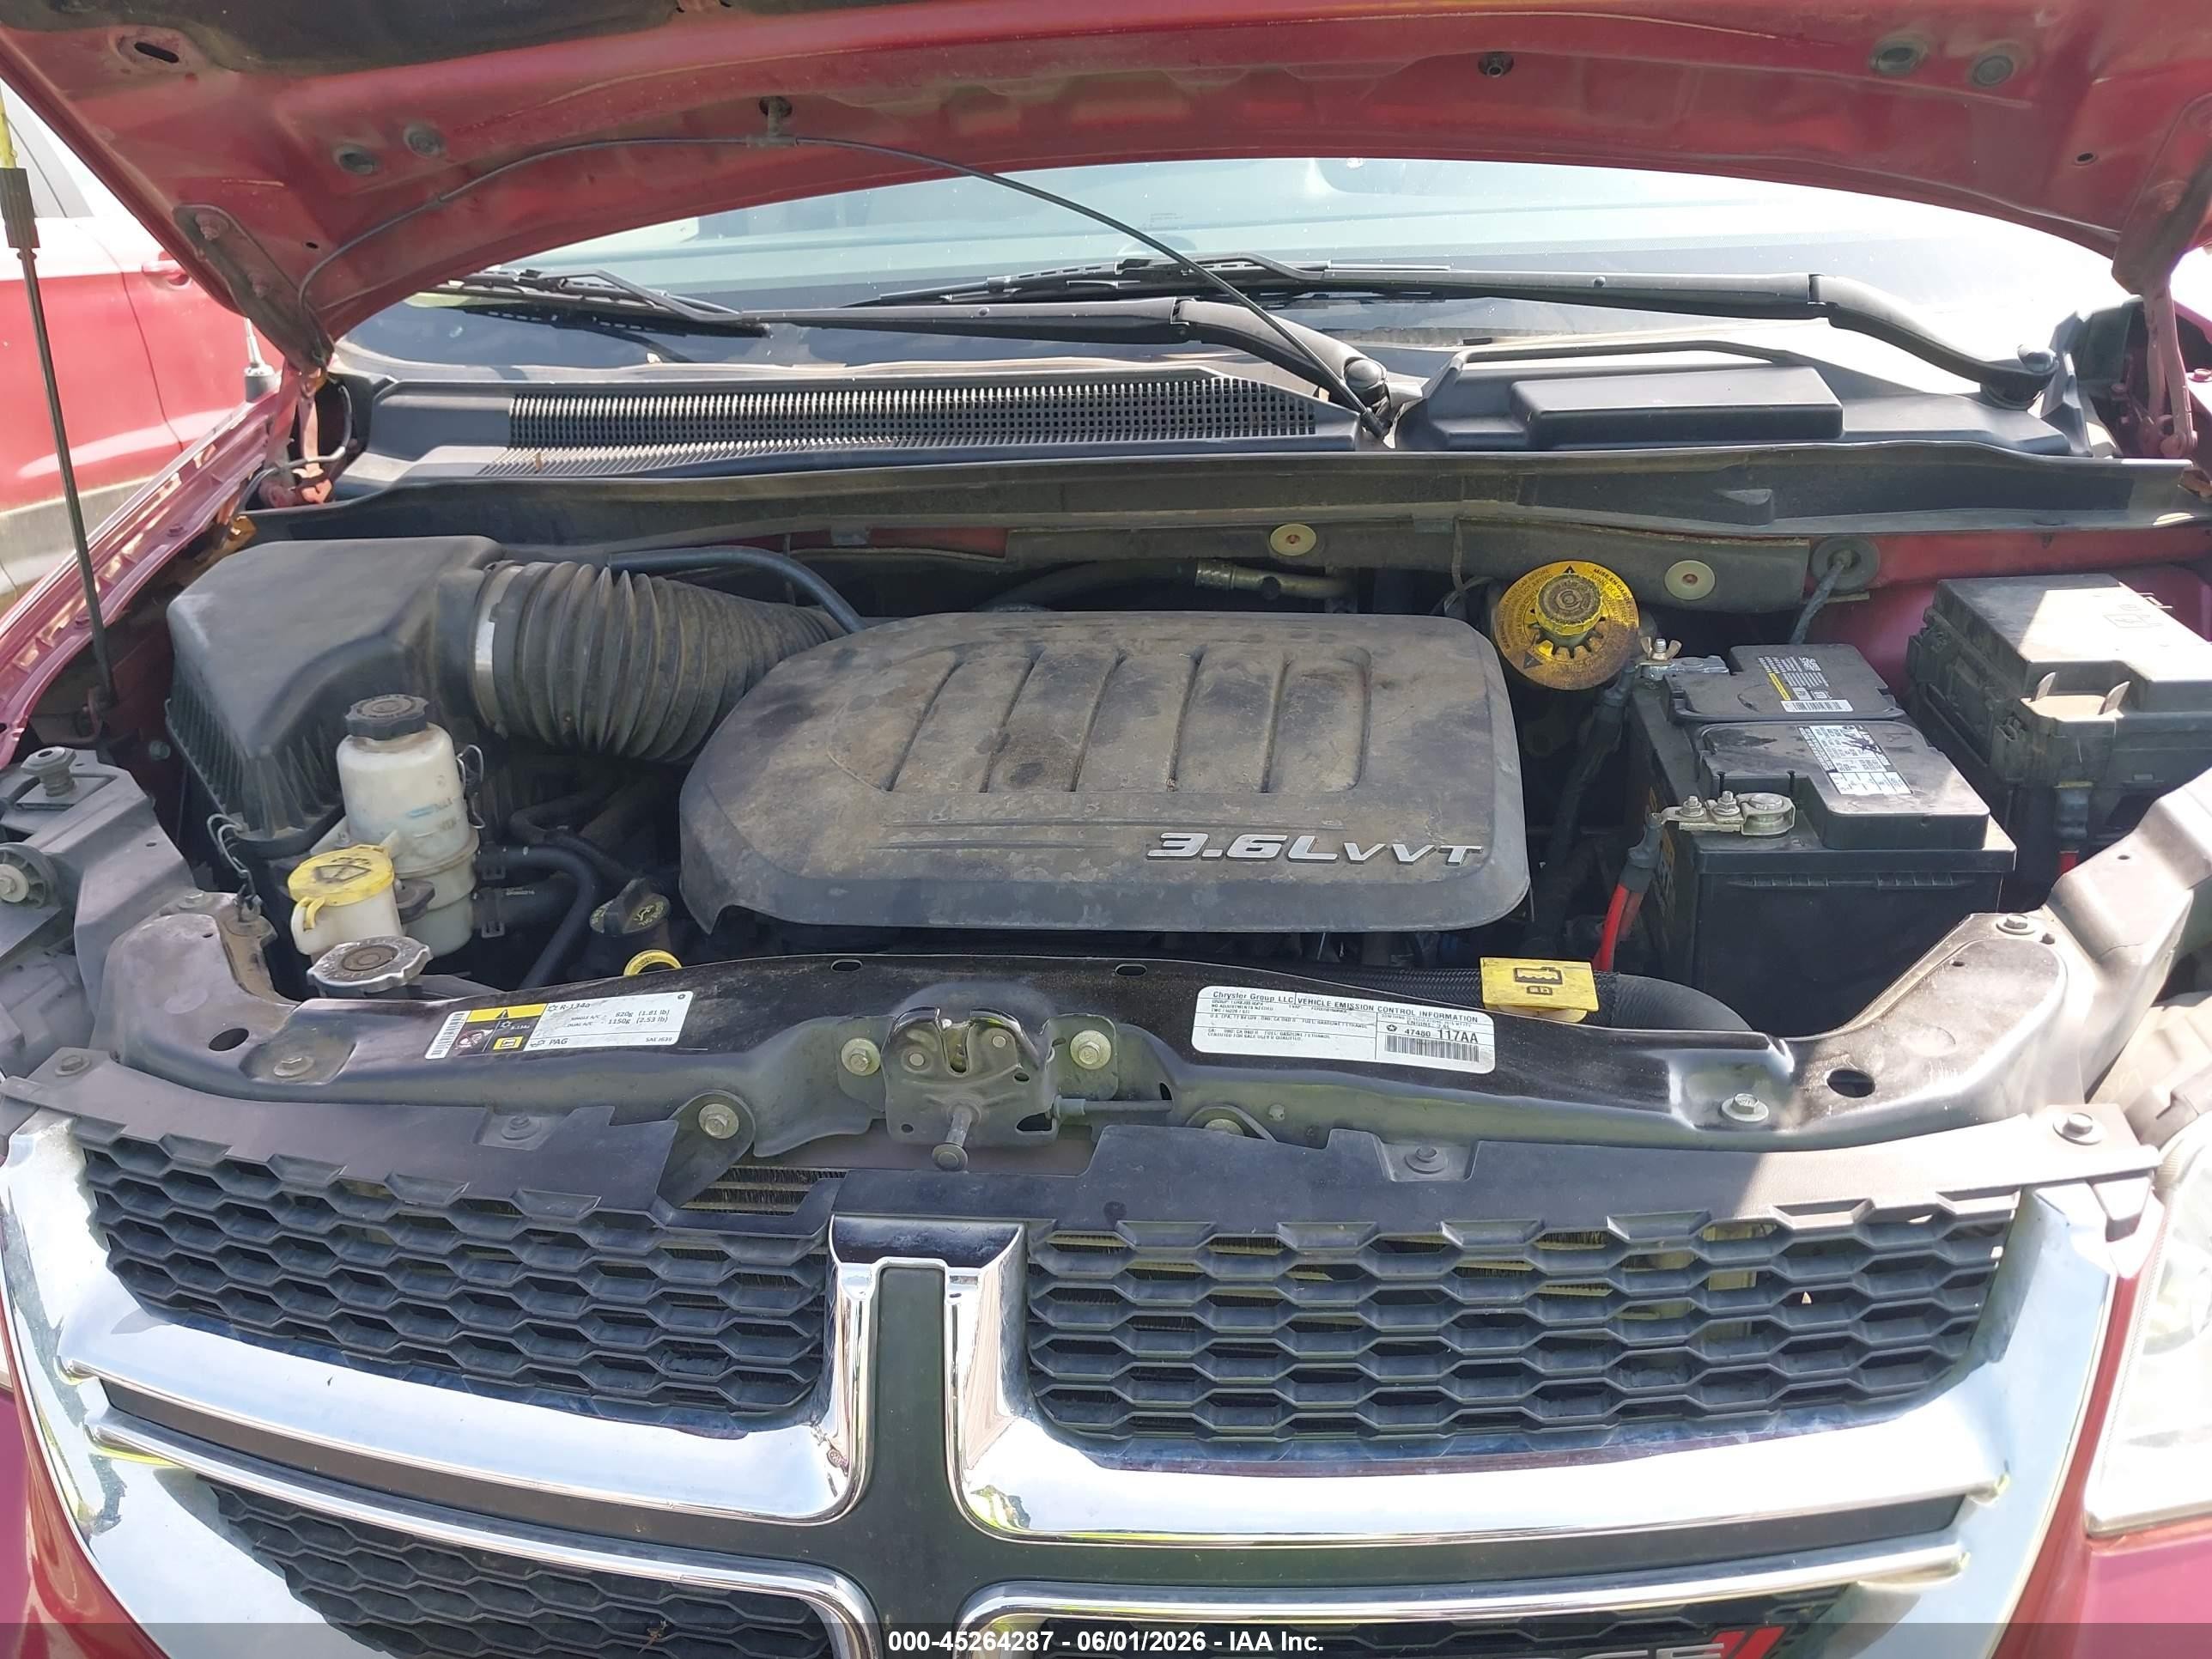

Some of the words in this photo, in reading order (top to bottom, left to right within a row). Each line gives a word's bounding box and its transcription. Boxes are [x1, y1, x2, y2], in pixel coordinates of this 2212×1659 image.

[1593, 568, 1609, 580] MISE
[1607, 577, 1618, 586] EN
[559, 1002, 591, 1012] R-134a
[1212, 991, 1248, 1000] Chrysler
[1250, 994, 1275, 1003] Group
[1297, 997, 1332, 1008] VEHICLE
[1334, 1000, 1375, 1012] EMISSION
[1377, 1005, 1416, 1017] CONTROL
[1419, 1010, 1479, 1023] INFORMATION
[549, 1037, 568, 1046] PAG
[1438, 1029, 1479, 1043] 117AA
